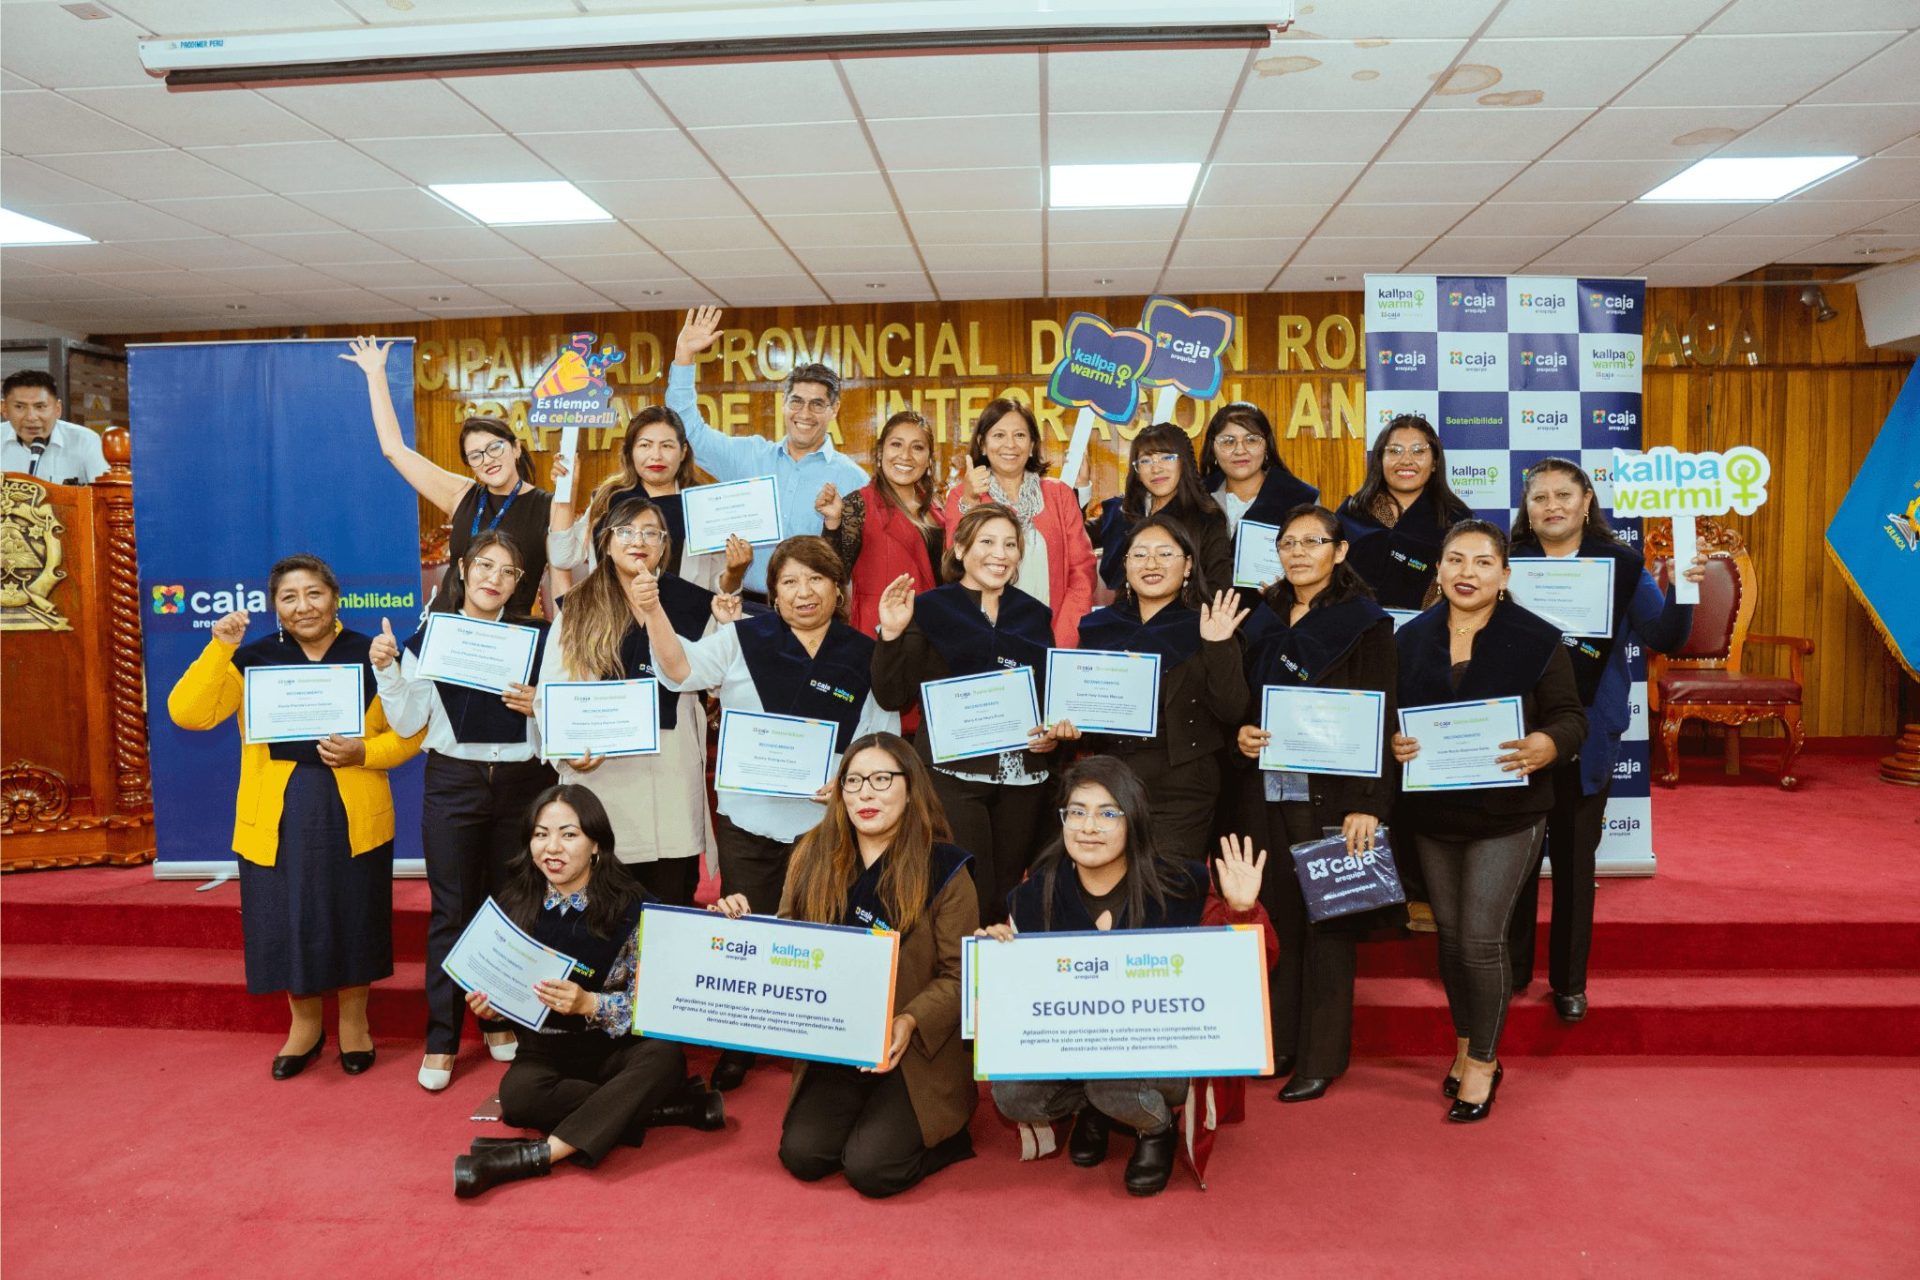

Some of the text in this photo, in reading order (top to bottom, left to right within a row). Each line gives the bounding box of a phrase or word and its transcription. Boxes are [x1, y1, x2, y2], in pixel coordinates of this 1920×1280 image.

[209, 40, 224, 48] PERU
[1378, 289, 1412, 299] kallpa
[1464, 293, 1495, 309] caja
[1535, 294, 1566, 309] caja
[1378, 299, 1413, 309] warmi
[1605, 294, 1634, 310] caja
[1278, 314, 1365, 371] RO
[1647, 309, 1767, 368] ACA
[1173, 338, 1210, 360] caja
[1592, 349, 1625, 360] kallpa
[1075, 348, 1117, 374] kallpa
[1395, 351, 1426, 367] caja
[1465, 352, 1496, 367] caja
[1536, 352, 1567, 368] caja
[1592, 359, 1626, 369] warmi
[1070, 362, 1114, 386] warmi
[537, 398, 600, 412] Es tiempo
[1287, 382, 1364, 440] AN
[530, 411, 615, 424] de celebrar!!!
[1445, 416, 1503, 425] Sostenibilidad
[1537, 411, 1568, 425] caja
[1608, 410, 1637, 426] caja
[1452, 466, 1486, 479] kallpa
[1614, 454, 1719, 488] kallpa
[1451, 476, 1486, 486] warmi
[1614, 480, 1722, 511] warmi
[337, 592, 414, 609] nibilidad
[1609, 816, 1640, 832] caja
[1330, 849, 1376, 874] caja
[1335, 870, 1366, 883] arequipa
[726, 941, 757, 957] caja
[772, 943, 810, 958] kallpa
[770, 956, 810, 970] warmi
[1074, 957, 1109, 974] caja
[1125, 954, 1168, 968] kallpa
[1125, 967, 1169, 978] warmi
[695, 974, 828, 1004] PRIMER PUESTO
[672, 1004, 699, 1015] programa
[715, 1002, 751, 1013] participación
[1032, 997, 1205, 1017] SEGUNDO PUESTO
[1068, 1027, 1109, 1036] participación
[1115, 1026, 1150, 1034] celebramos
[1020, 1037, 1050, 1046] programa
[1130, 1035, 1156, 1044] mujeres
[1060, 1045, 1098, 1053] demostrado
